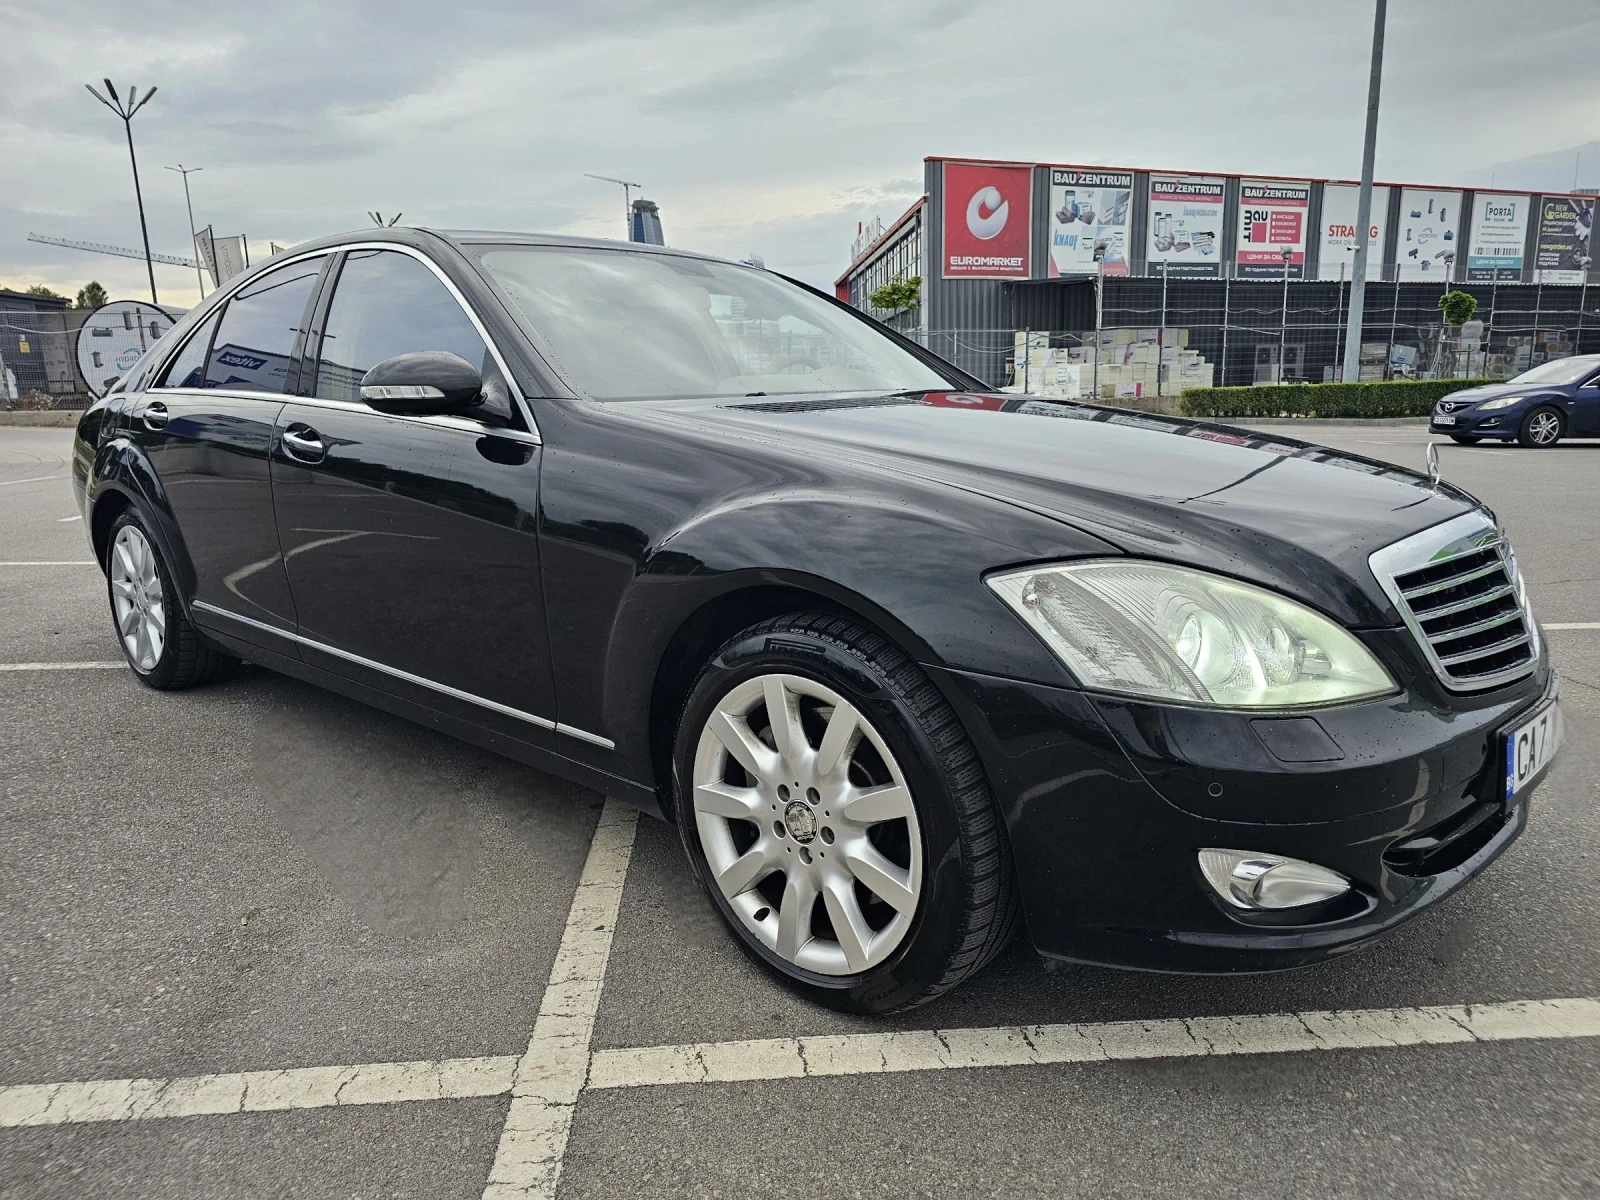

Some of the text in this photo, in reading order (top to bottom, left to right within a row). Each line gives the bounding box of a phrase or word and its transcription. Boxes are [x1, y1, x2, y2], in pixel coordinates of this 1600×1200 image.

[1489, 207, 1512, 216] PORTA
[1328, 225, 1379, 238] STRAG
[950, 256, 1024, 266] EUROMARKET
